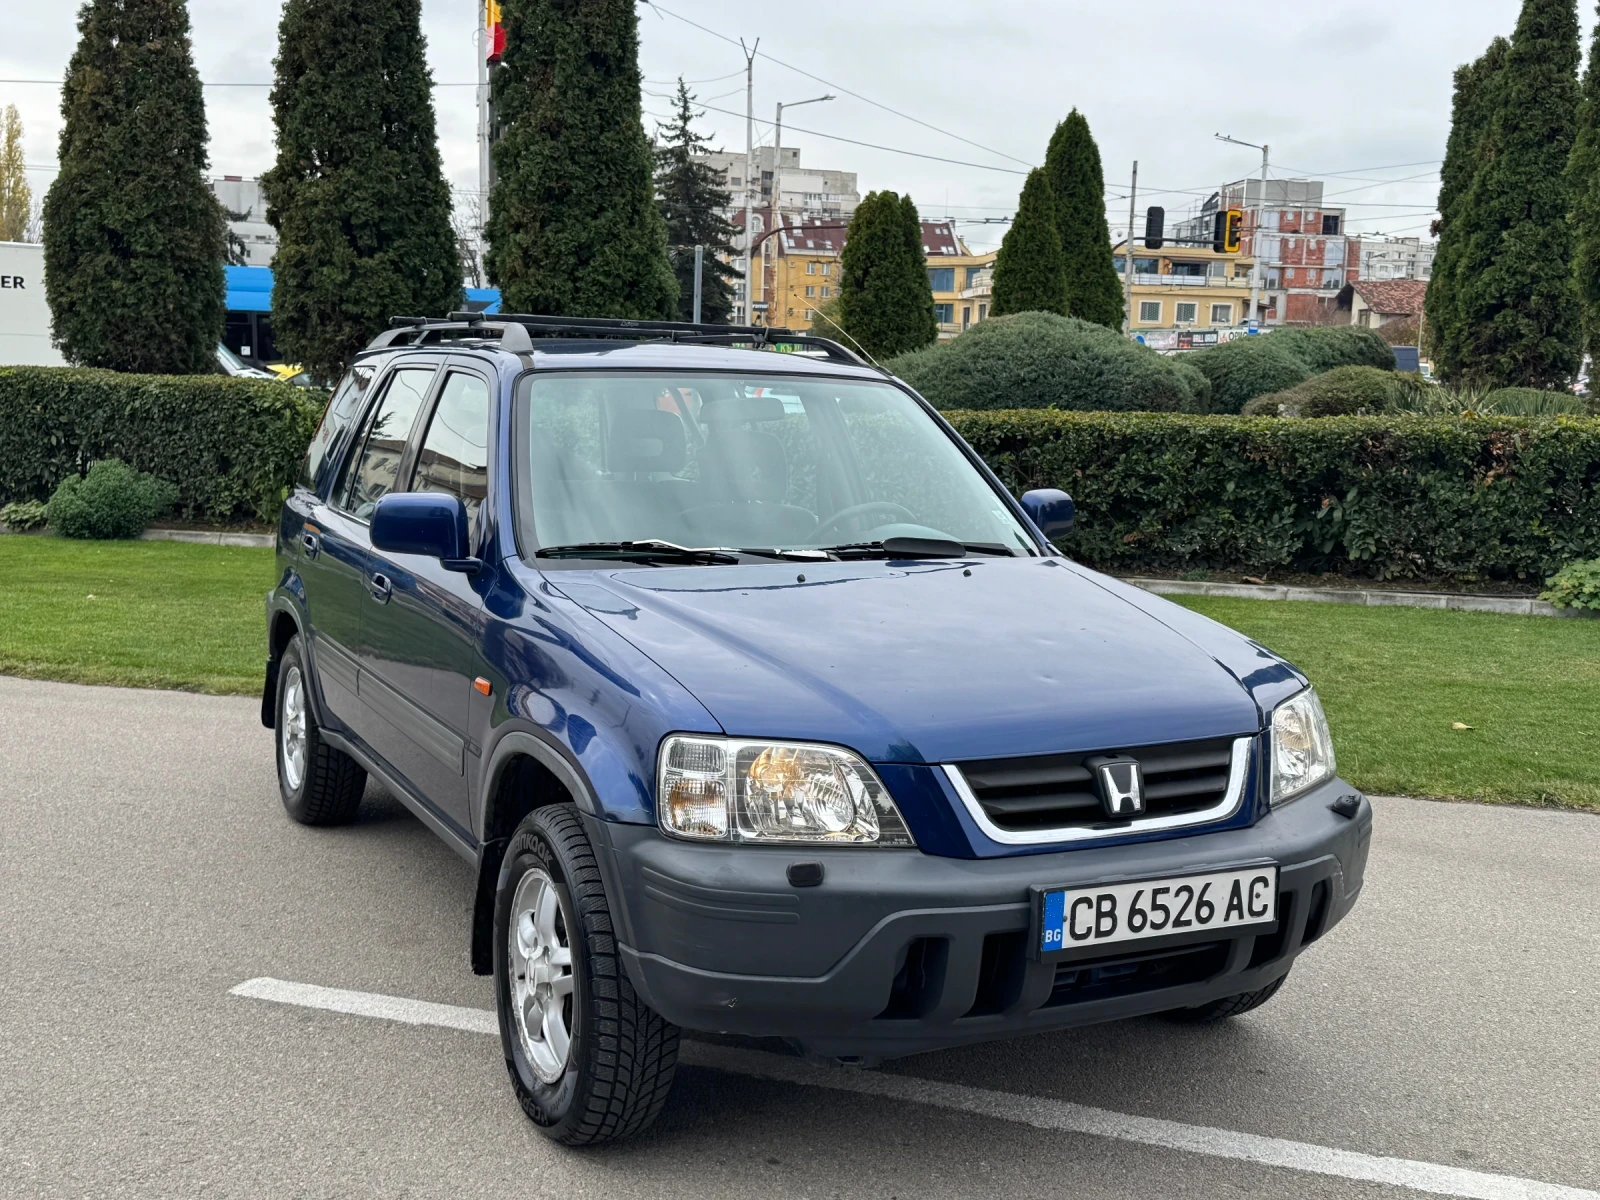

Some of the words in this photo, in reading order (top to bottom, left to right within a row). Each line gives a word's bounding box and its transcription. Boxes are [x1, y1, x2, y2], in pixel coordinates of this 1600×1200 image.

[1, 275, 26, 289] ER
[506, 833, 553, 869] ankook
[1069, 893, 1118, 941] CB
[1127, 882, 1216, 934] 6526
[1223, 875, 1270, 923] AC
[1045, 928, 1061, 943] BG
